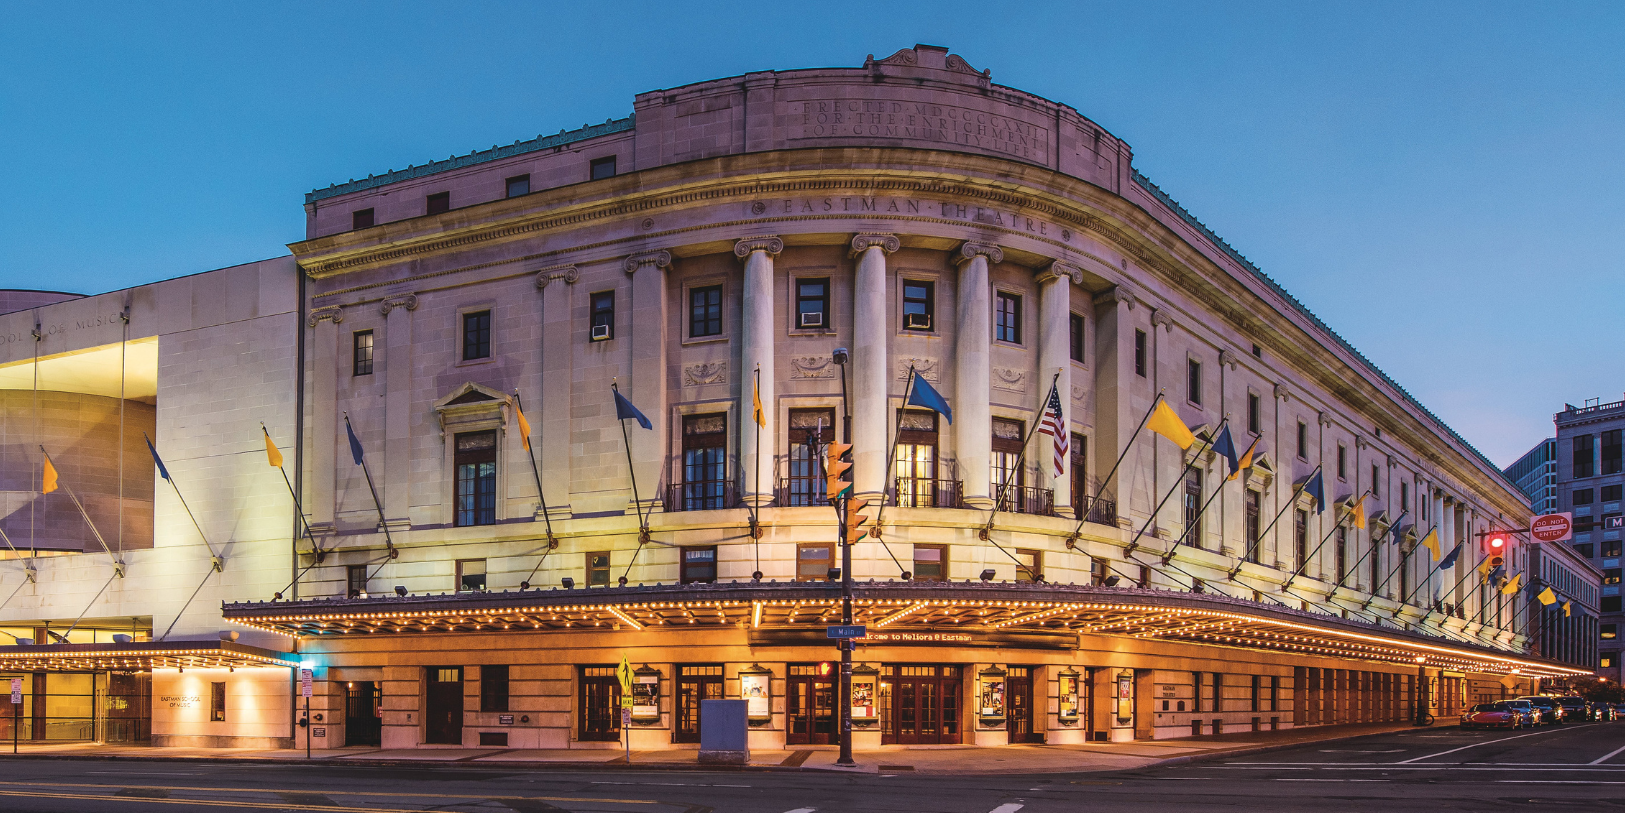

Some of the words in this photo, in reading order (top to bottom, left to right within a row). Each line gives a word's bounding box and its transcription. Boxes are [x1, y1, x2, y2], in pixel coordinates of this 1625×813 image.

[803, 101, 902, 114] ERECTED
[803, 113, 843, 125] FOR
[856, 113, 896, 125] THE
[909, 115, 1039, 149] ENRICHMENT
[813, 125, 838, 136] OF
[853, 125, 981, 146] COMMUNITY
[993, 139, 1030, 158] LIFE
[783, 198, 920, 214] EASTMAN
[938, 202, 1047, 236] THEATRE
[75, 313, 117, 330] MUSIC
[1539, 530, 1562, 538] ENTER
[838, 628, 855, 636] Main
[855, 632, 889, 641] lcome
[891, 633, 901, 641] to
[902, 633, 933, 641] Meliora
[941, 634, 972, 642] Eastman
